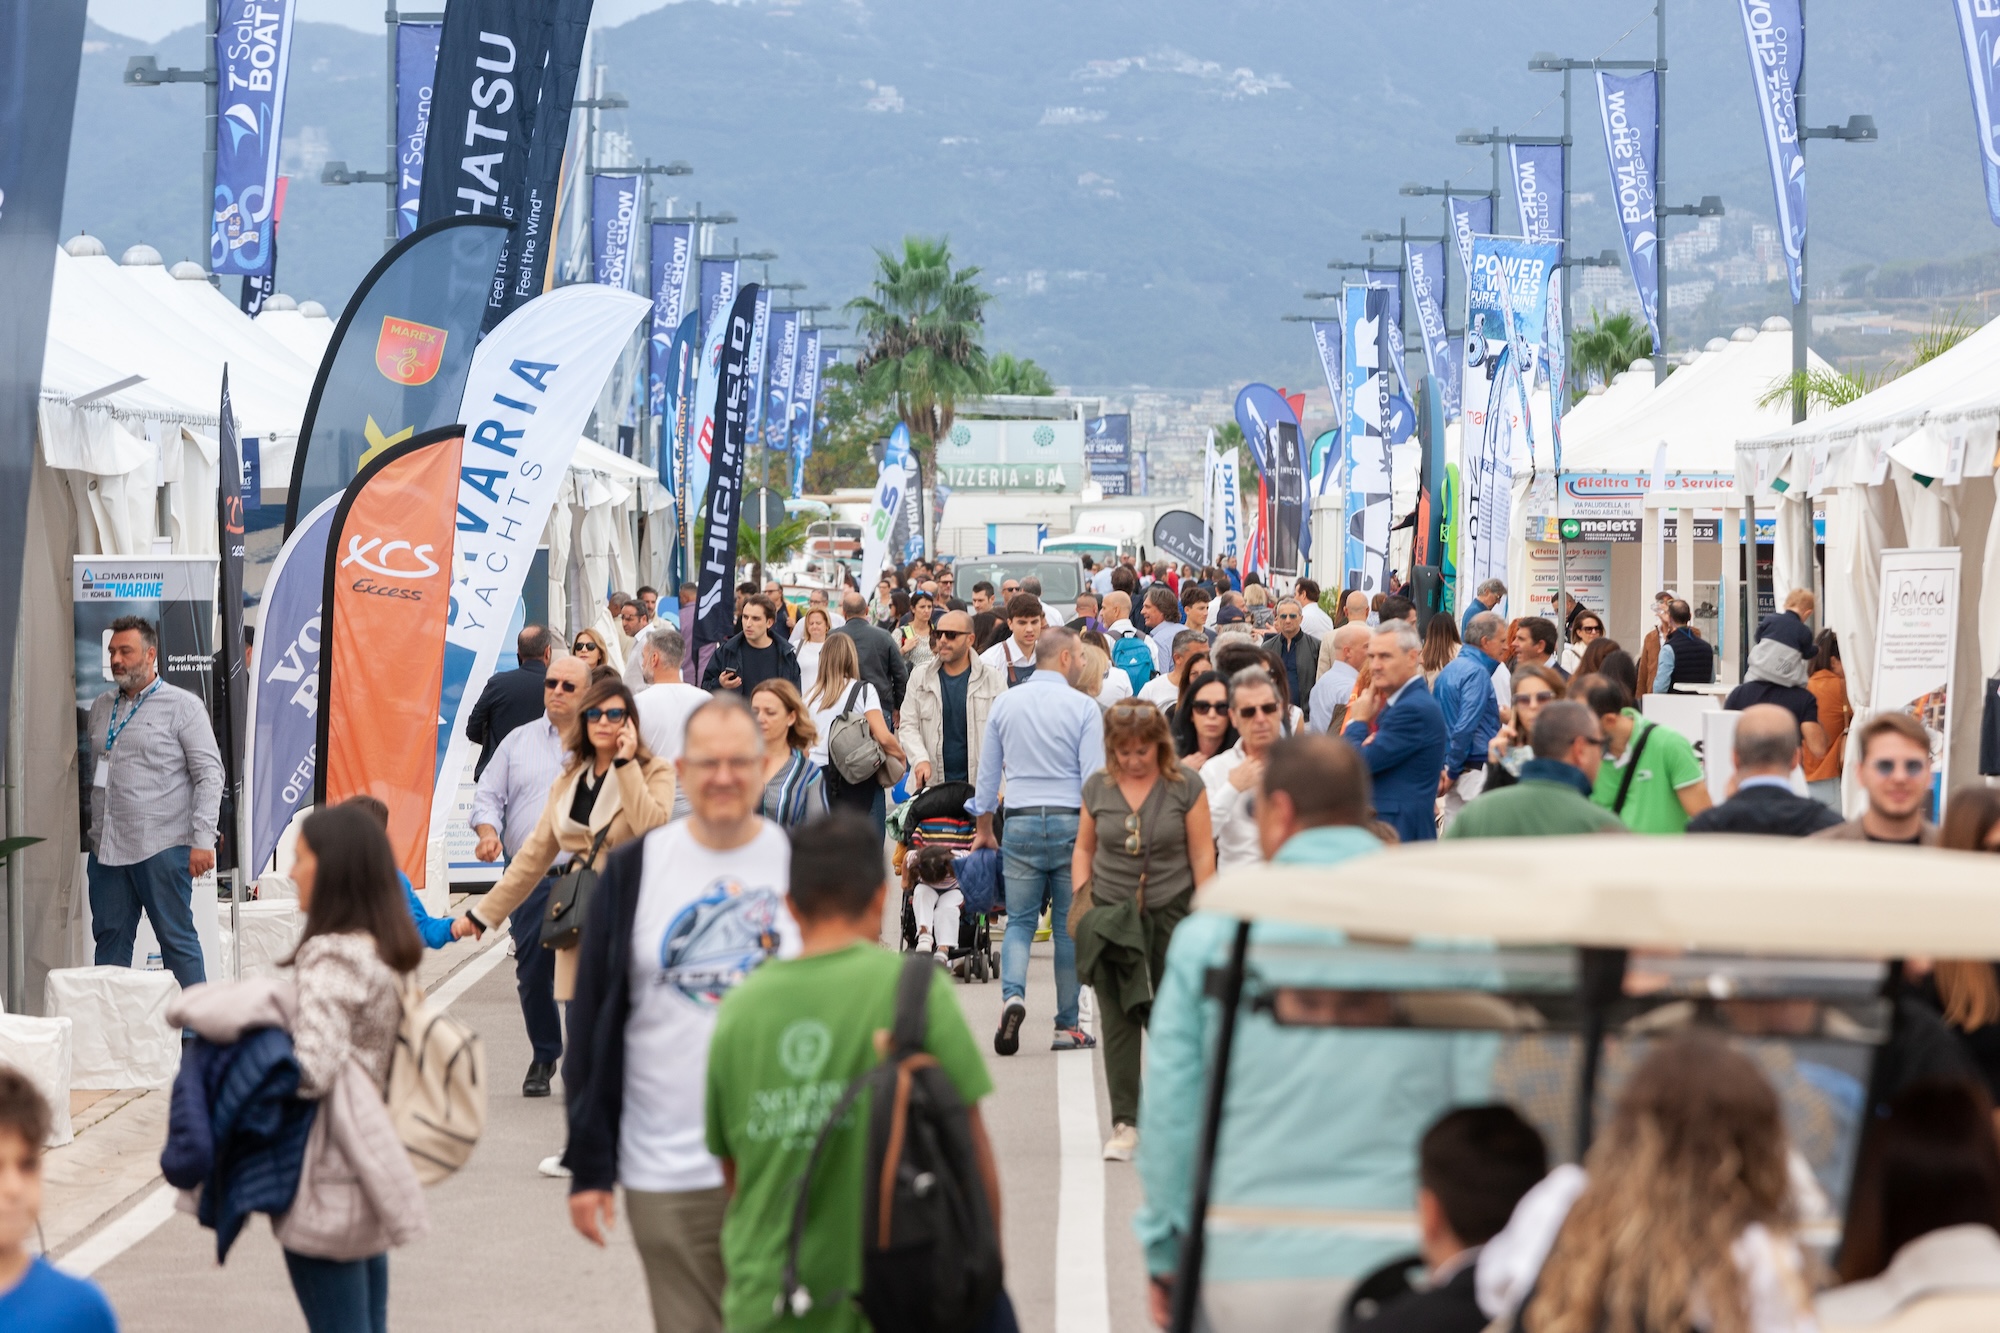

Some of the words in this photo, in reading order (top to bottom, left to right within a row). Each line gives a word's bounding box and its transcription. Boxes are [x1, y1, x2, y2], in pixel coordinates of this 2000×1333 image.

[228, 0, 255, 60] Sale
[248, 5, 279, 92] BOAT
[228, 64, 248, 91] 7°
[403, 86, 432, 165] Salerno
[520, 240, 536, 265] the
[672, 236, 688, 284] SHOW
[1474, 253, 1545, 279] POWER
[489, 277, 506, 308] Feel
[516, 269, 532, 297] Feel
[664, 287, 682, 328] BOAT
[1470, 290, 1497, 303] PURE
[390, 323, 437, 344] MAREX
[783, 319, 795, 357] SHOW
[779, 357, 790, 388] BOAT
[1577, 477, 1629, 488] Afeltra
[1634, 477, 1676, 489] Tuo
[1681, 477, 1734, 489] Service
[1223, 464, 1238, 557] SUZUKI
[1580, 520, 1637, 532] melett
[1703, 528, 1714, 537] 30
[463, 459, 541, 631] YACHTS
[94, 572, 164, 581] LOMBARDINI
[1534, 574, 1556, 582] CENTRO
[1583, 574, 1602, 582] TURBO
[114, 582, 164, 598] MARINE
[351, 578, 423, 601] Excess
[1889, 605, 1945, 617] Positano
[167, 654, 187, 664] Gruppi
[167, 664, 176, 672] da
[176, 664, 180, 672] 4
